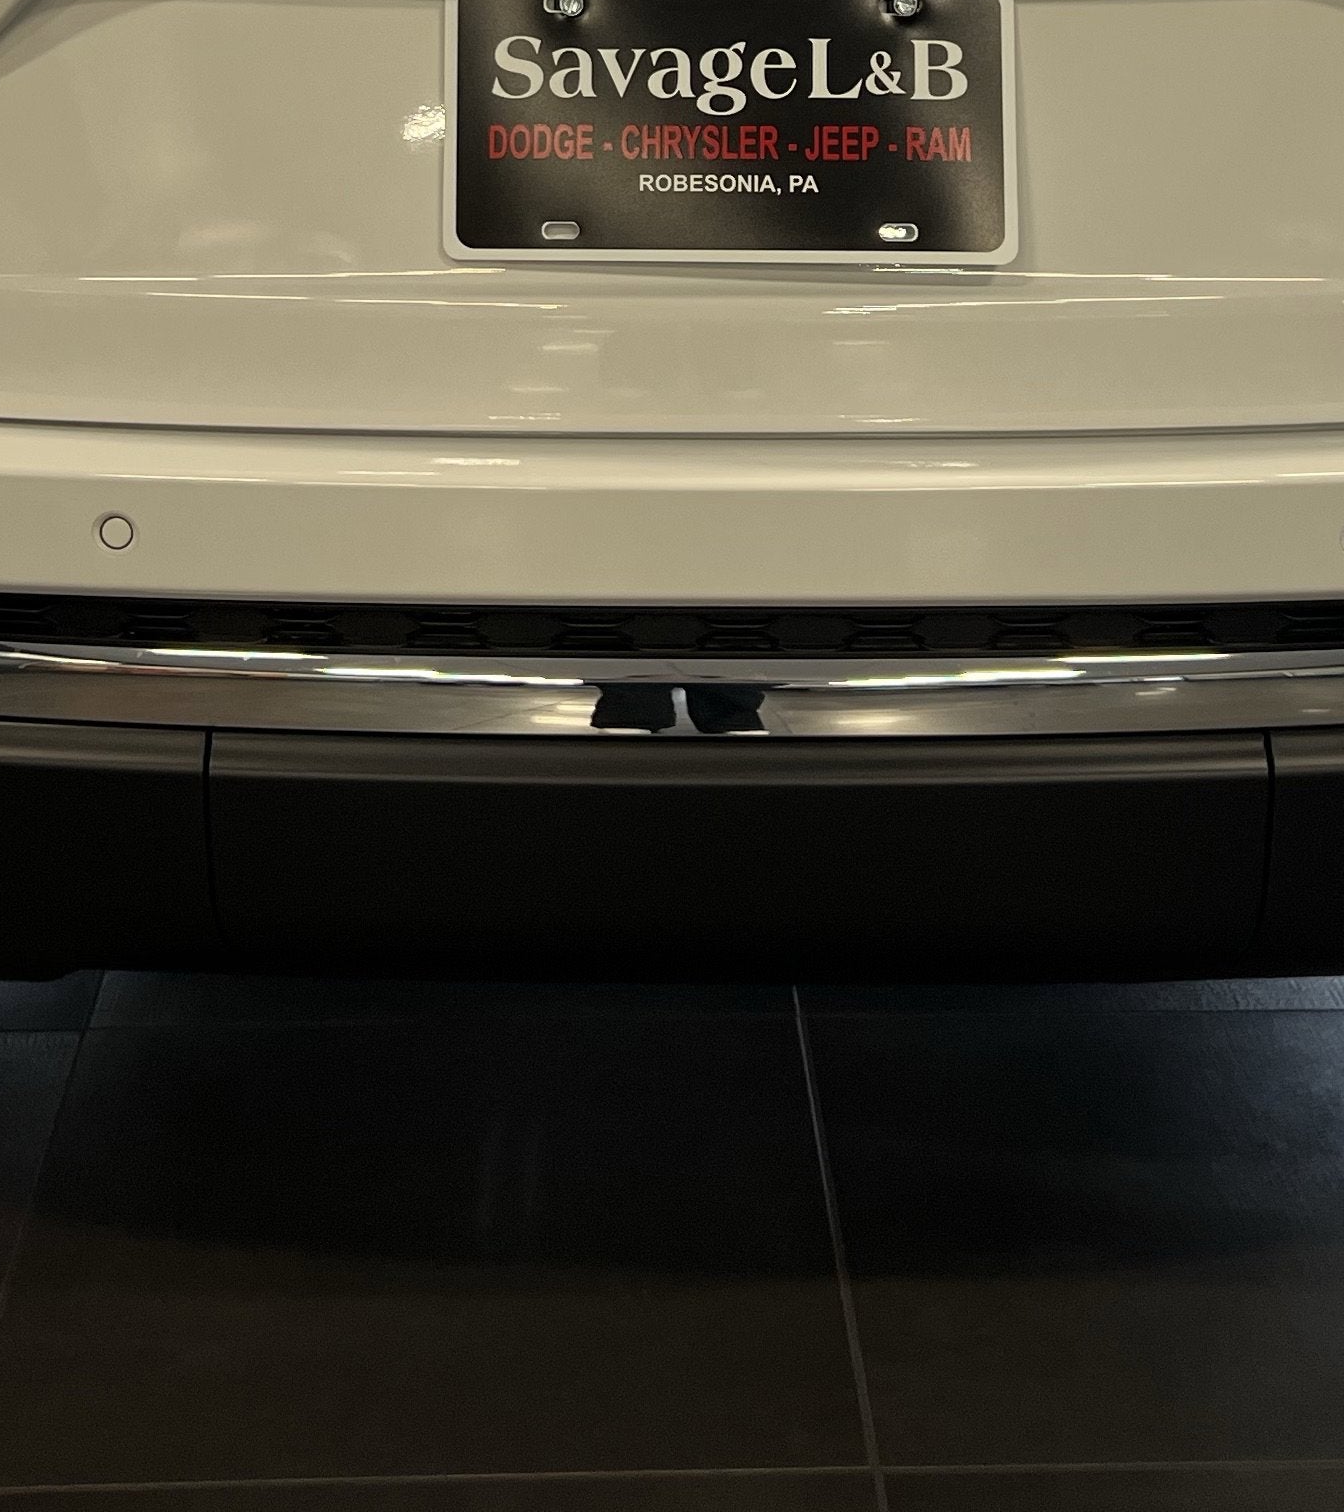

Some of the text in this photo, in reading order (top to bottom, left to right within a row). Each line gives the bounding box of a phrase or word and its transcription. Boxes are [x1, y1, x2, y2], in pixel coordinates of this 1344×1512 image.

[488, 123, 594, 160] DODGE
[621, 123, 779, 161] CHRYSLER
[805, 125, 880, 162] JEEP
[905, 126, 972, 162] RAM
[639, 174, 820, 196] ROBESONIA, PA
